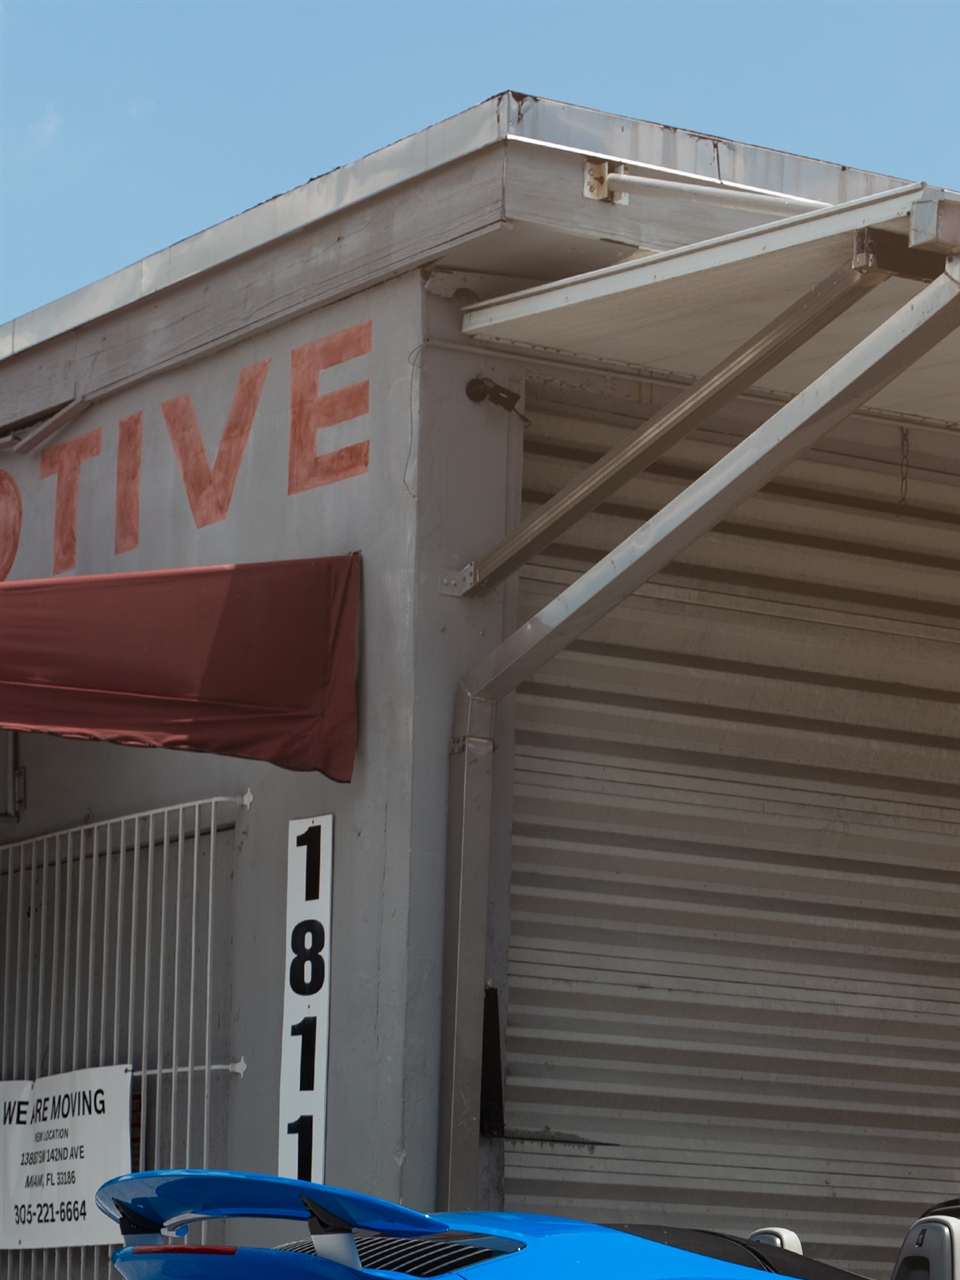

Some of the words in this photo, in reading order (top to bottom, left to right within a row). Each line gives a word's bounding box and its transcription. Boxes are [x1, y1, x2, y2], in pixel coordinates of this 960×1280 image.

[3, 1100, 29, 1126] WE
[30, 1097, 50, 1125] ARE
[50, 1088, 106, 1121] MOVING
[44, 1127, 69, 1141] LOCATION
[46, 1147, 68, 1162] 142ND
[69, 1145, 85, 1160] AVE
[46, 1172, 55, 1186] FL
[56, 1170, 76, 1186] 33186
[14, 1199, 87, 1225] 305-221-6664
